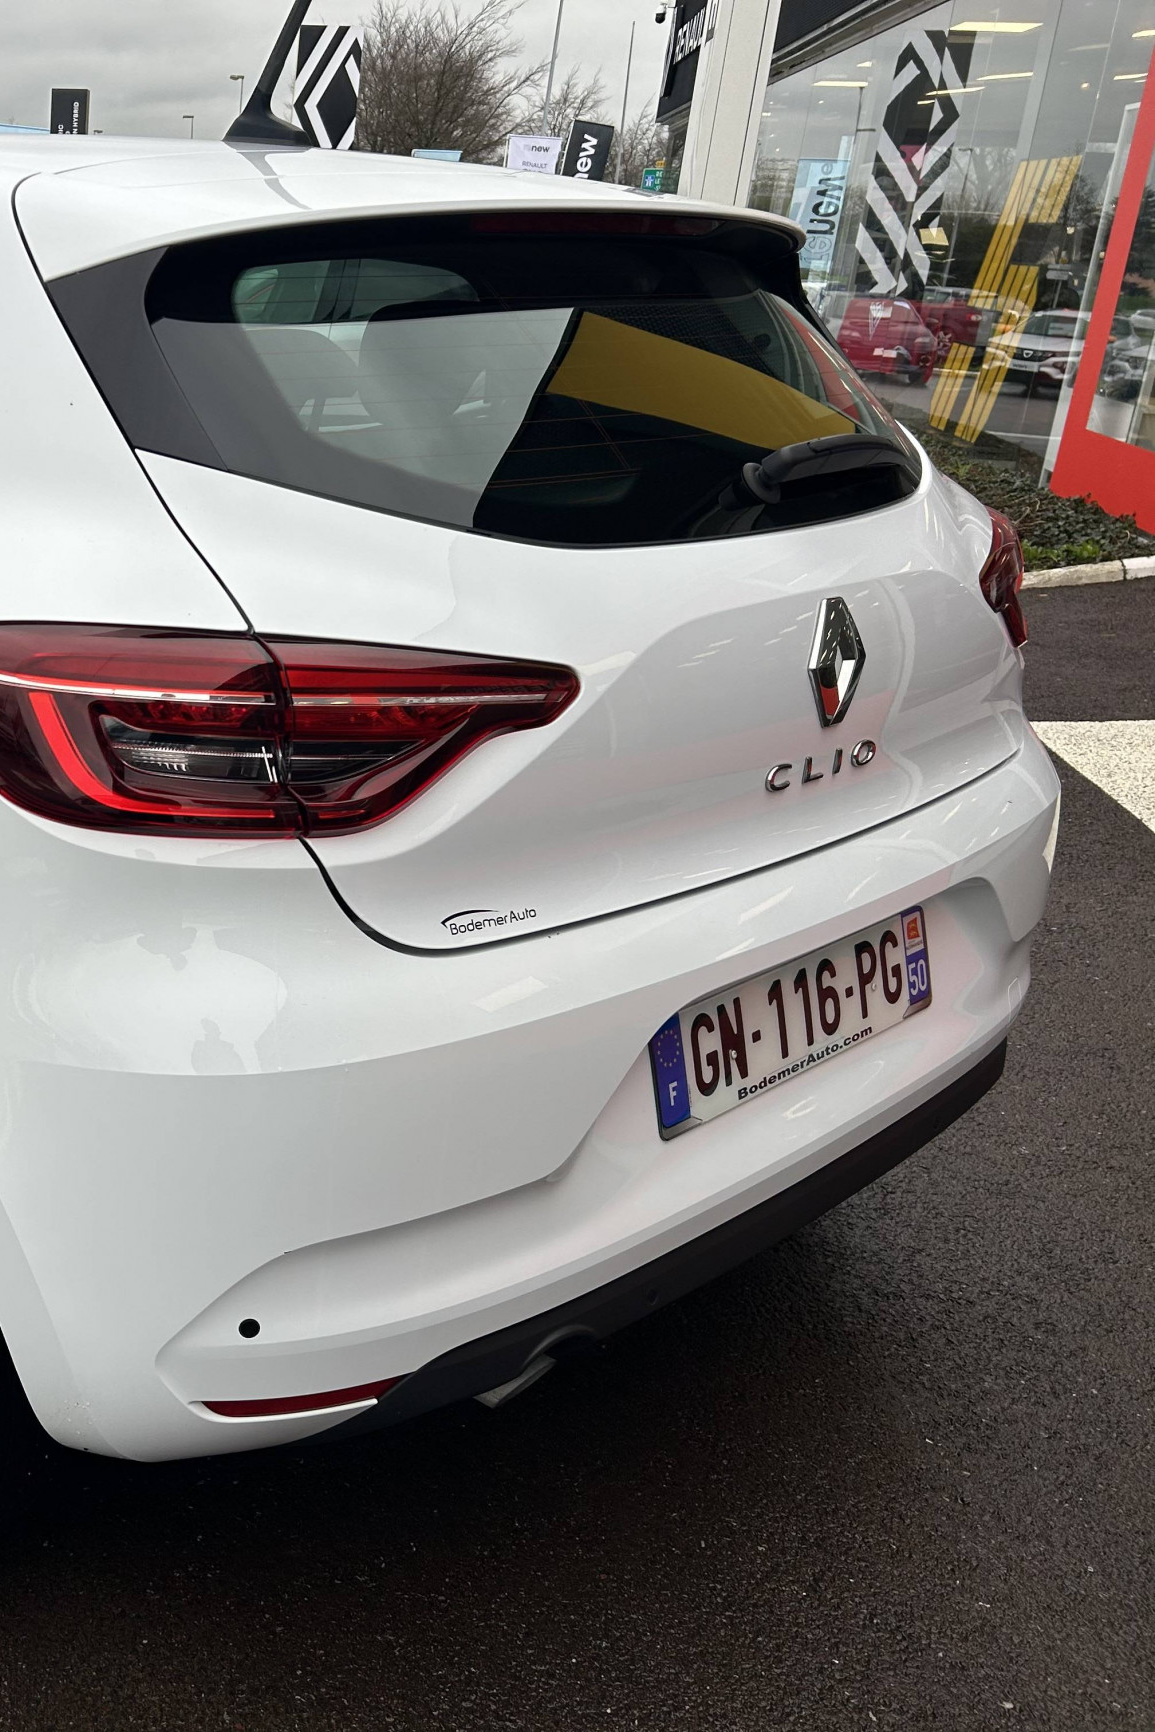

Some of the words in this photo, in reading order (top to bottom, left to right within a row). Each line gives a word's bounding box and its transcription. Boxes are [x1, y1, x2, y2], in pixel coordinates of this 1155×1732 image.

[521, 160, 548, 169] RENAULT
[765, 739, 877, 792] CLIO
[908, 959, 928, 996] 50
[690, 929, 903, 1097] GN-116-PG
[737, 1025, 873, 1101] BodemerAuto.com
[669, 1081, 678, 1107] F
